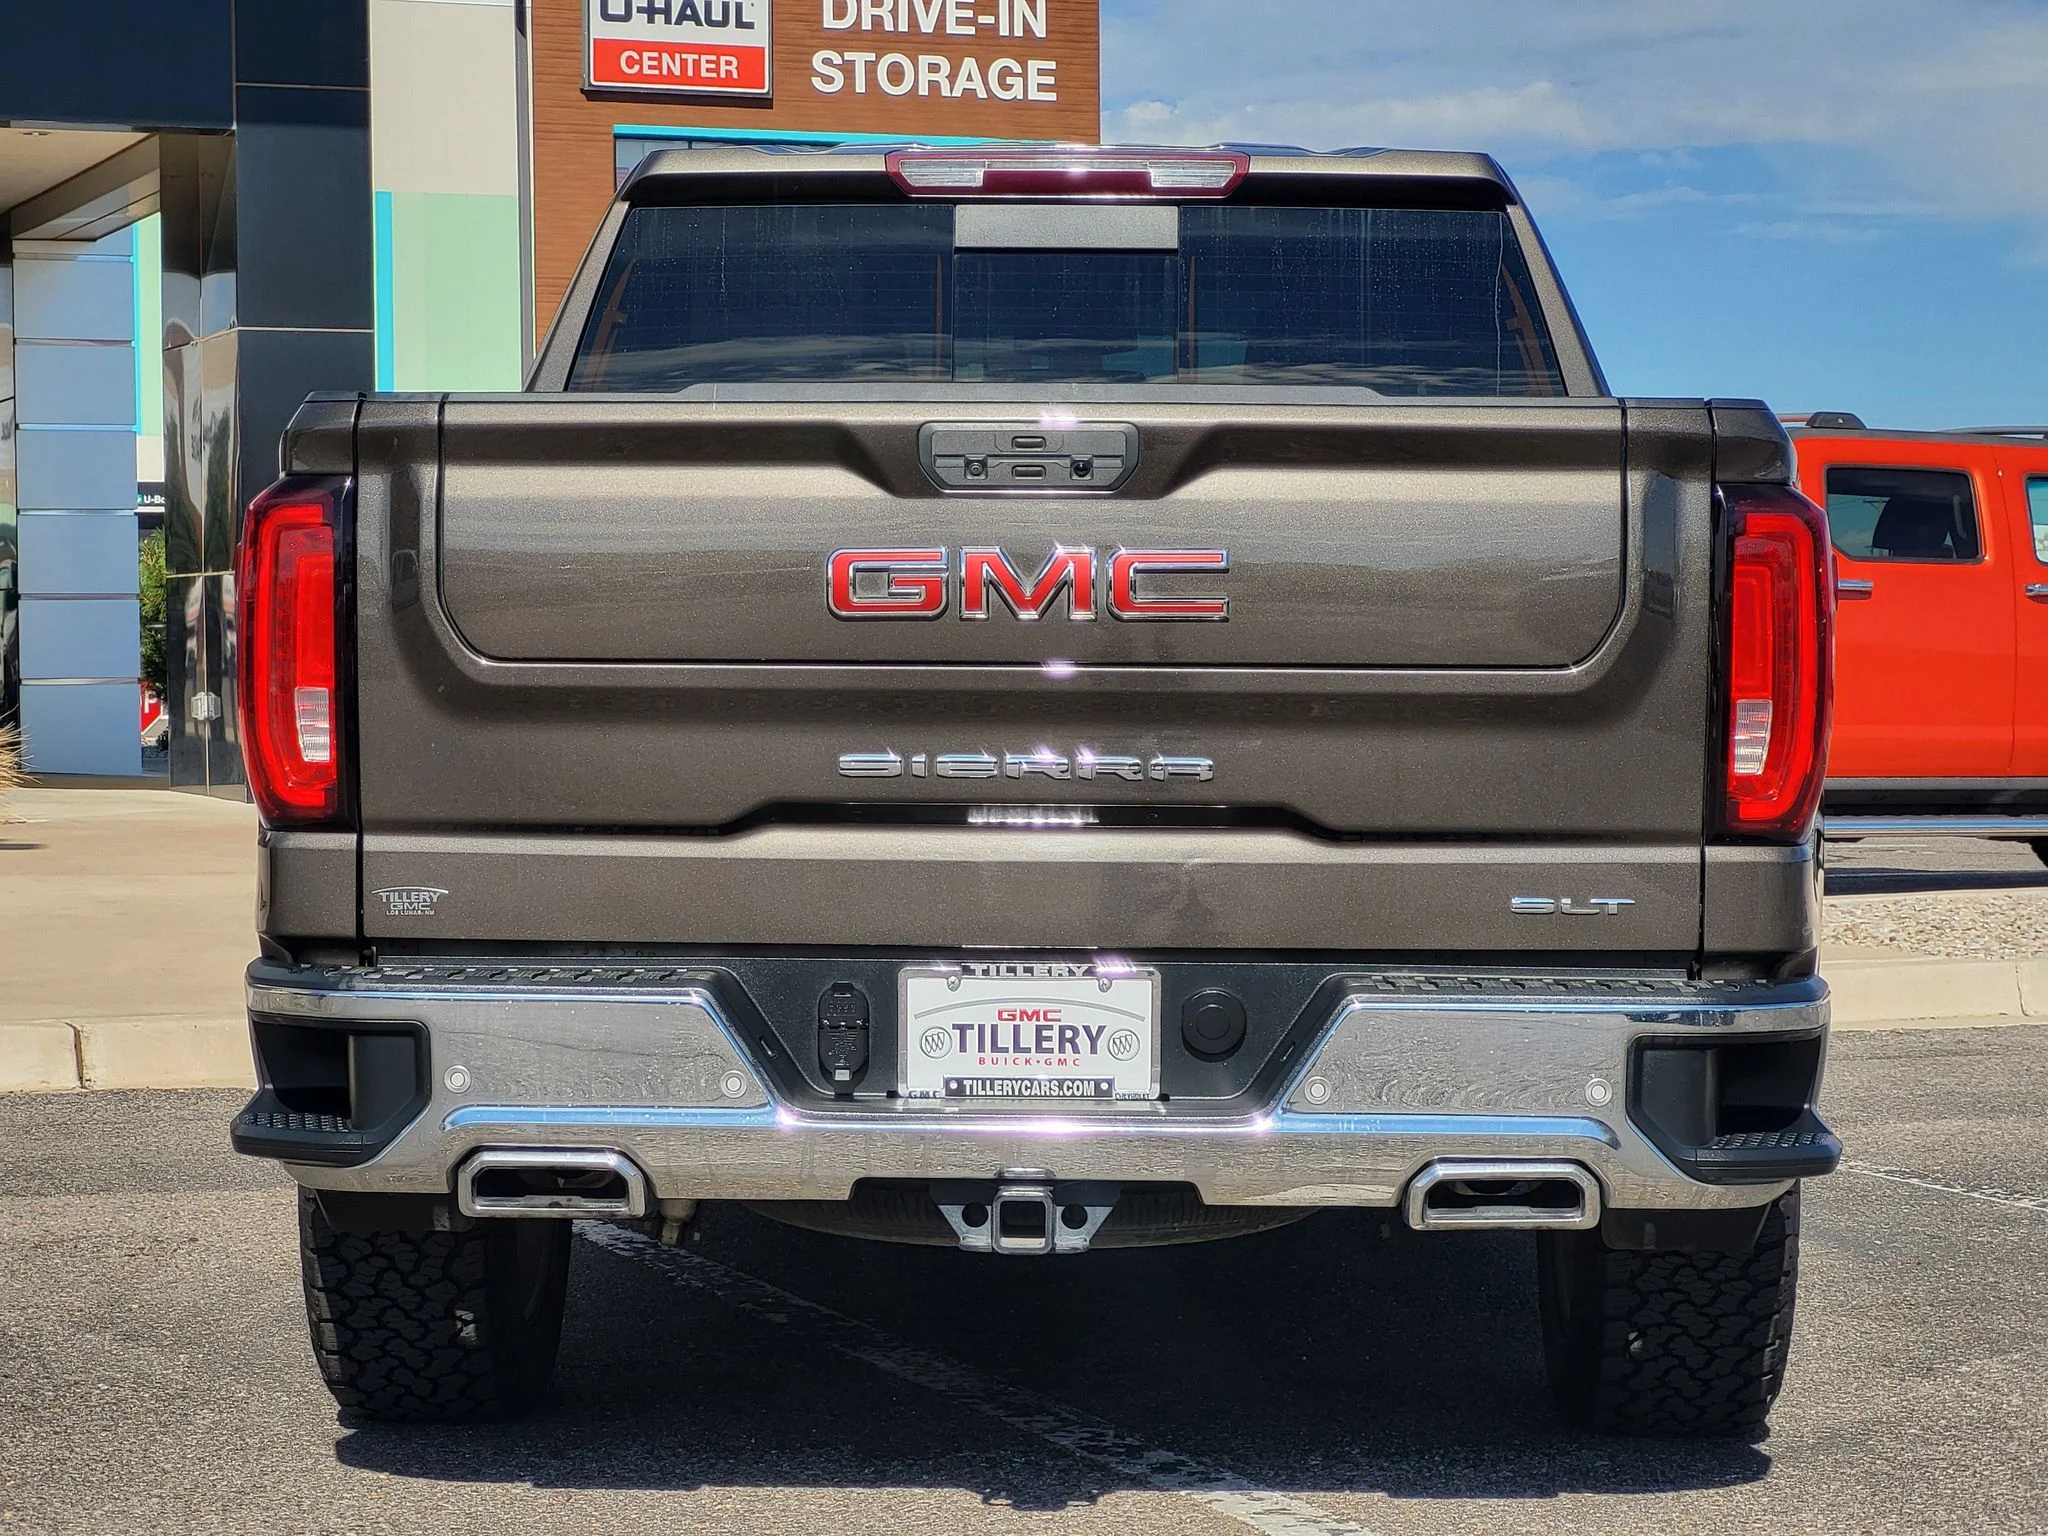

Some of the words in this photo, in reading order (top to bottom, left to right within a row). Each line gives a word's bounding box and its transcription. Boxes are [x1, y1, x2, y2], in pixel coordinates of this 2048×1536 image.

[600, 0, 755, 30] U-HAUL
[822, 0, 1048, 39] DRIVE-IN
[619, 49, 740, 80] CENTER
[810, 49, 1058, 102] STORAGE
[827, 546, 1231, 622] GMC
[838, 752, 1215, 782] SIERRA
[379, 891, 440, 902] TILLERY
[390, 902, 431, 910] GMC
[1510, 896, 1637, 916] SLT
[970, 964, 1089, 978] TILLERY
[997, 1008, 1062, 1023] GMC
[952, 1023, 1107, 1055] TILLERY
[963, 1079, 1096, 1097] TILLERYCARS.COM
